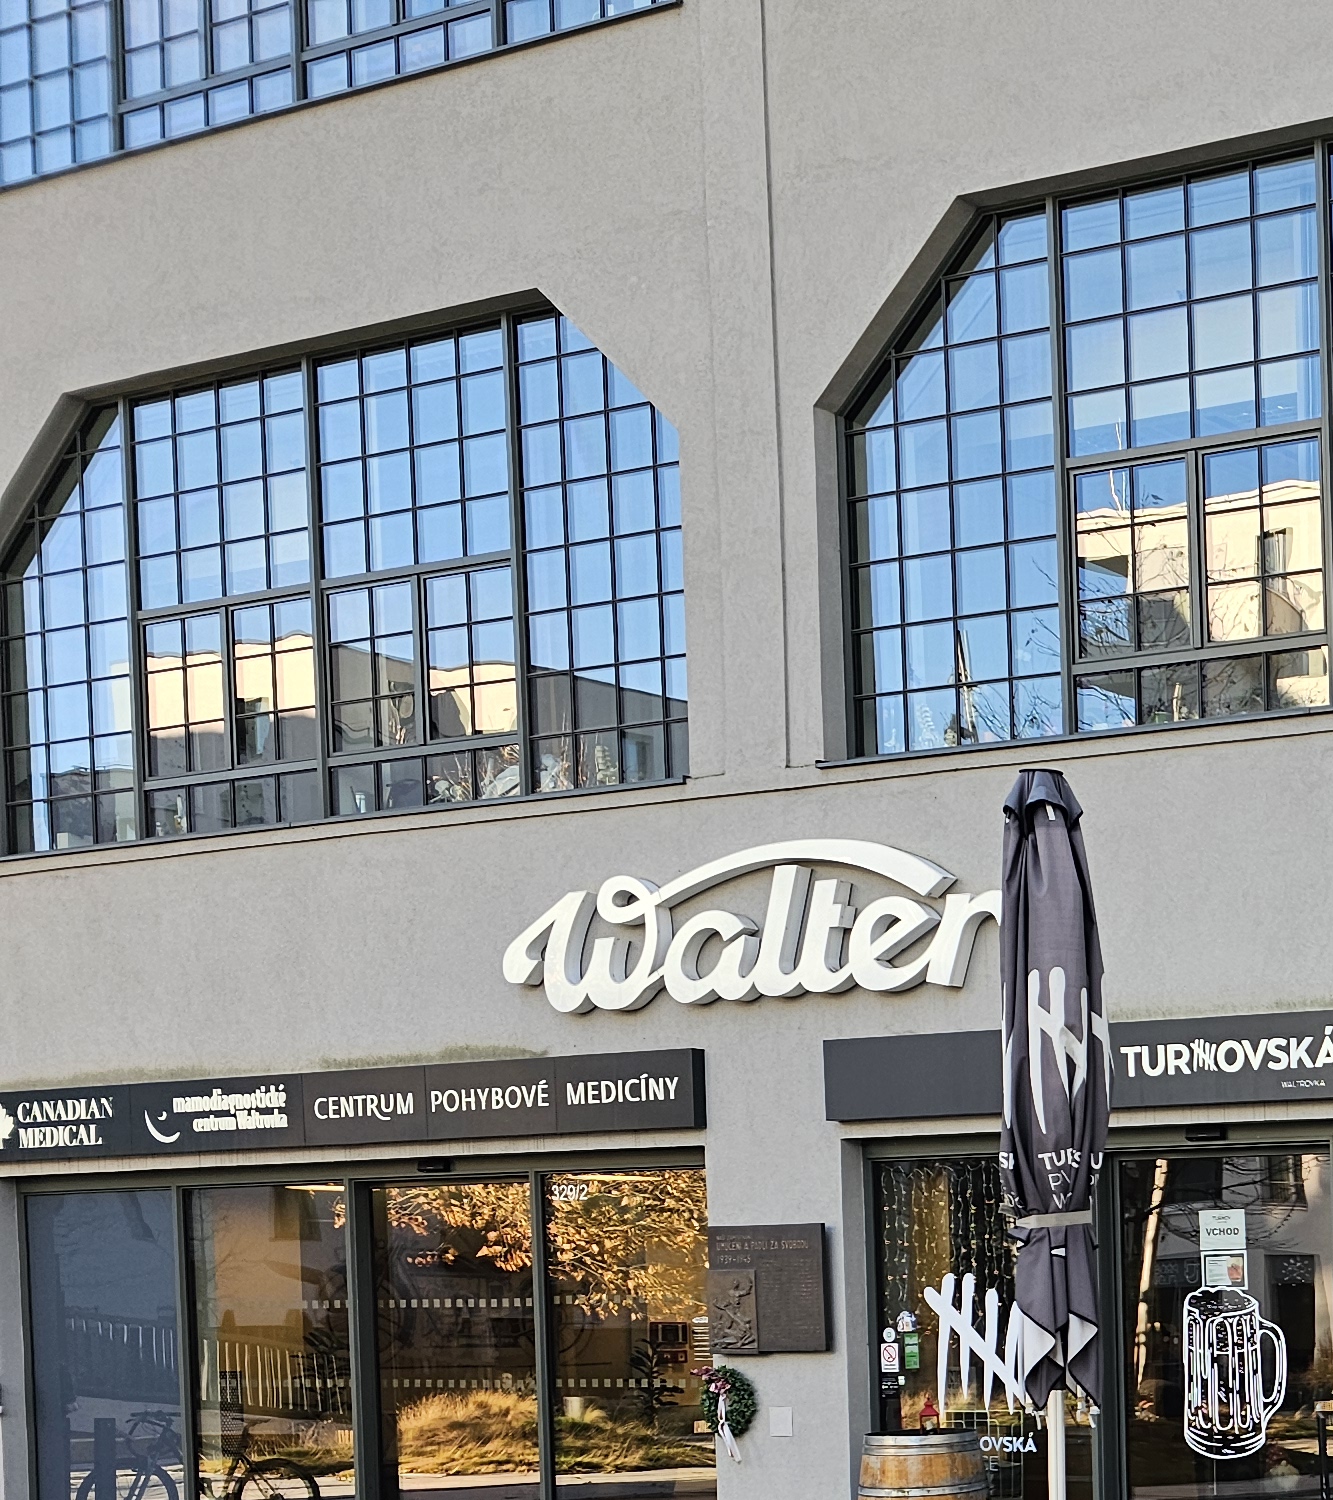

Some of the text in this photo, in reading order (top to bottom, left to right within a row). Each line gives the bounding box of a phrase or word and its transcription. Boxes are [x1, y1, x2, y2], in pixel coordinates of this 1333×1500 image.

[502, 838, 1002, 1015] Walter
[314, 1073, 679, 1120] CENTRUM POHYBOVÉ MEDICÍNY
[17, 1097, 113, 1123] CANADIAN
[18, 1123, 102, 1149] MEDICAL
[552, 1184, 588, 1200] 329/2
[1205, 1227, 1240, 1236] VCHOD
[979, 1432, 1037, 1452] OVSKÁ
